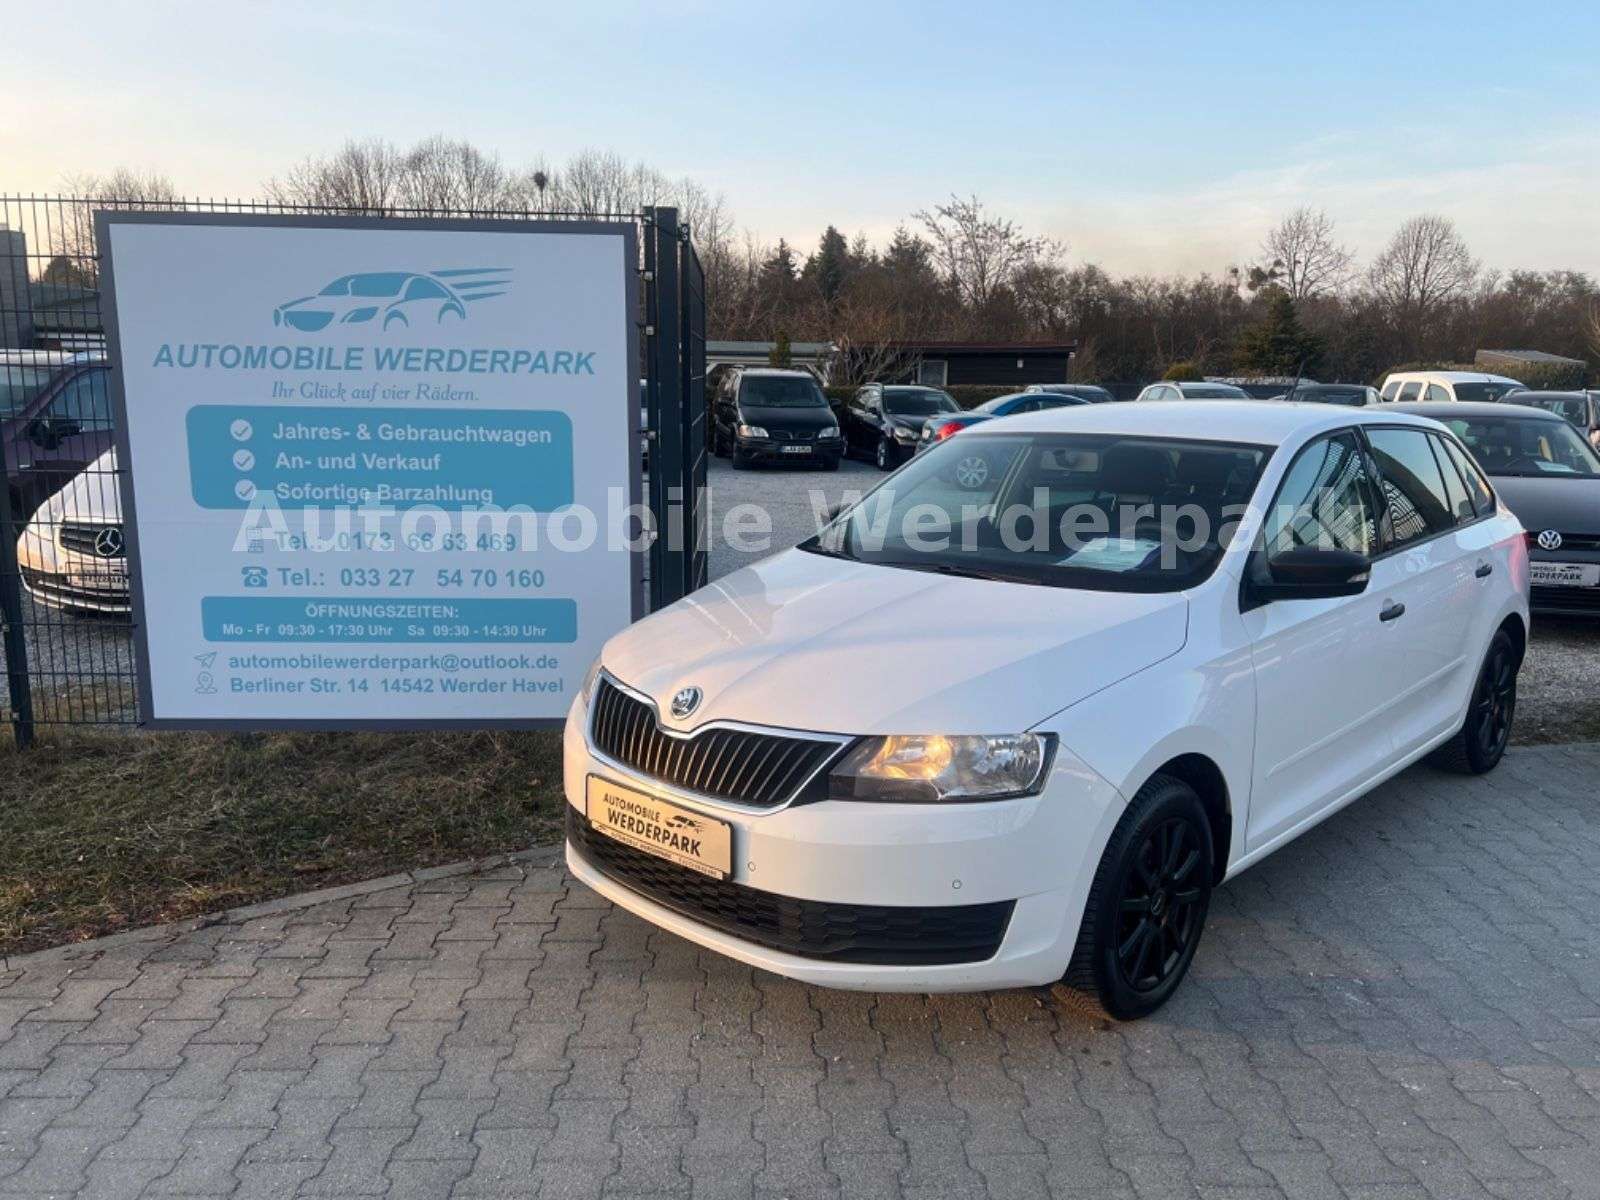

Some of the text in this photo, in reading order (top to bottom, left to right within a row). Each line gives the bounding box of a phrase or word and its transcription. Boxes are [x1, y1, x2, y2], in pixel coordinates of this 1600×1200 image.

[152, 343, 597, 375] AUTOMOBILE WERDERPARK
[272, 381, 479, 402] Ihr Glück auf vier Rädern.
[272, 423, 552, 446] Jahres- & Gebrauchtwagen
[275, 452, 441, 471] An- und Verkauf
[276, 482, 493, 505] Sofortige Barzahlung
[338, 532, 392, 550] 0173
[408, 533, 433, 551] 66
[443, 533, 468, 551] 63
[476, 533, 516, 551] 469
[277, 568, 545, 588] Tel.: 033 27 54 70 160
[305, 603, 460, 619] ÖFFNUNGSZEITEN:
[223, 623, 243, 636] Mo
[256, 623, 272, 636] Fr
[278, 624, 315, 636] 09:30
[328, 624, 366, 636] 17:30
[368, 624, 393, 636] Uhr
[407, 625, 425, 637] Sa
[433, 625, 469, 637] 09:30
[484, 625, 519, 637] 14:30
[522, 625, 547, 637] Uhr
[229, 653, 559, 673] automobilewerderpark@outlook.de
[230, 677, 564, 694] Berliner Str. 14 14542 Werder Havel
[603, 793, 660, 821] AUTOMOBILE
[607, 807, 702, 858] WERDERPARK
